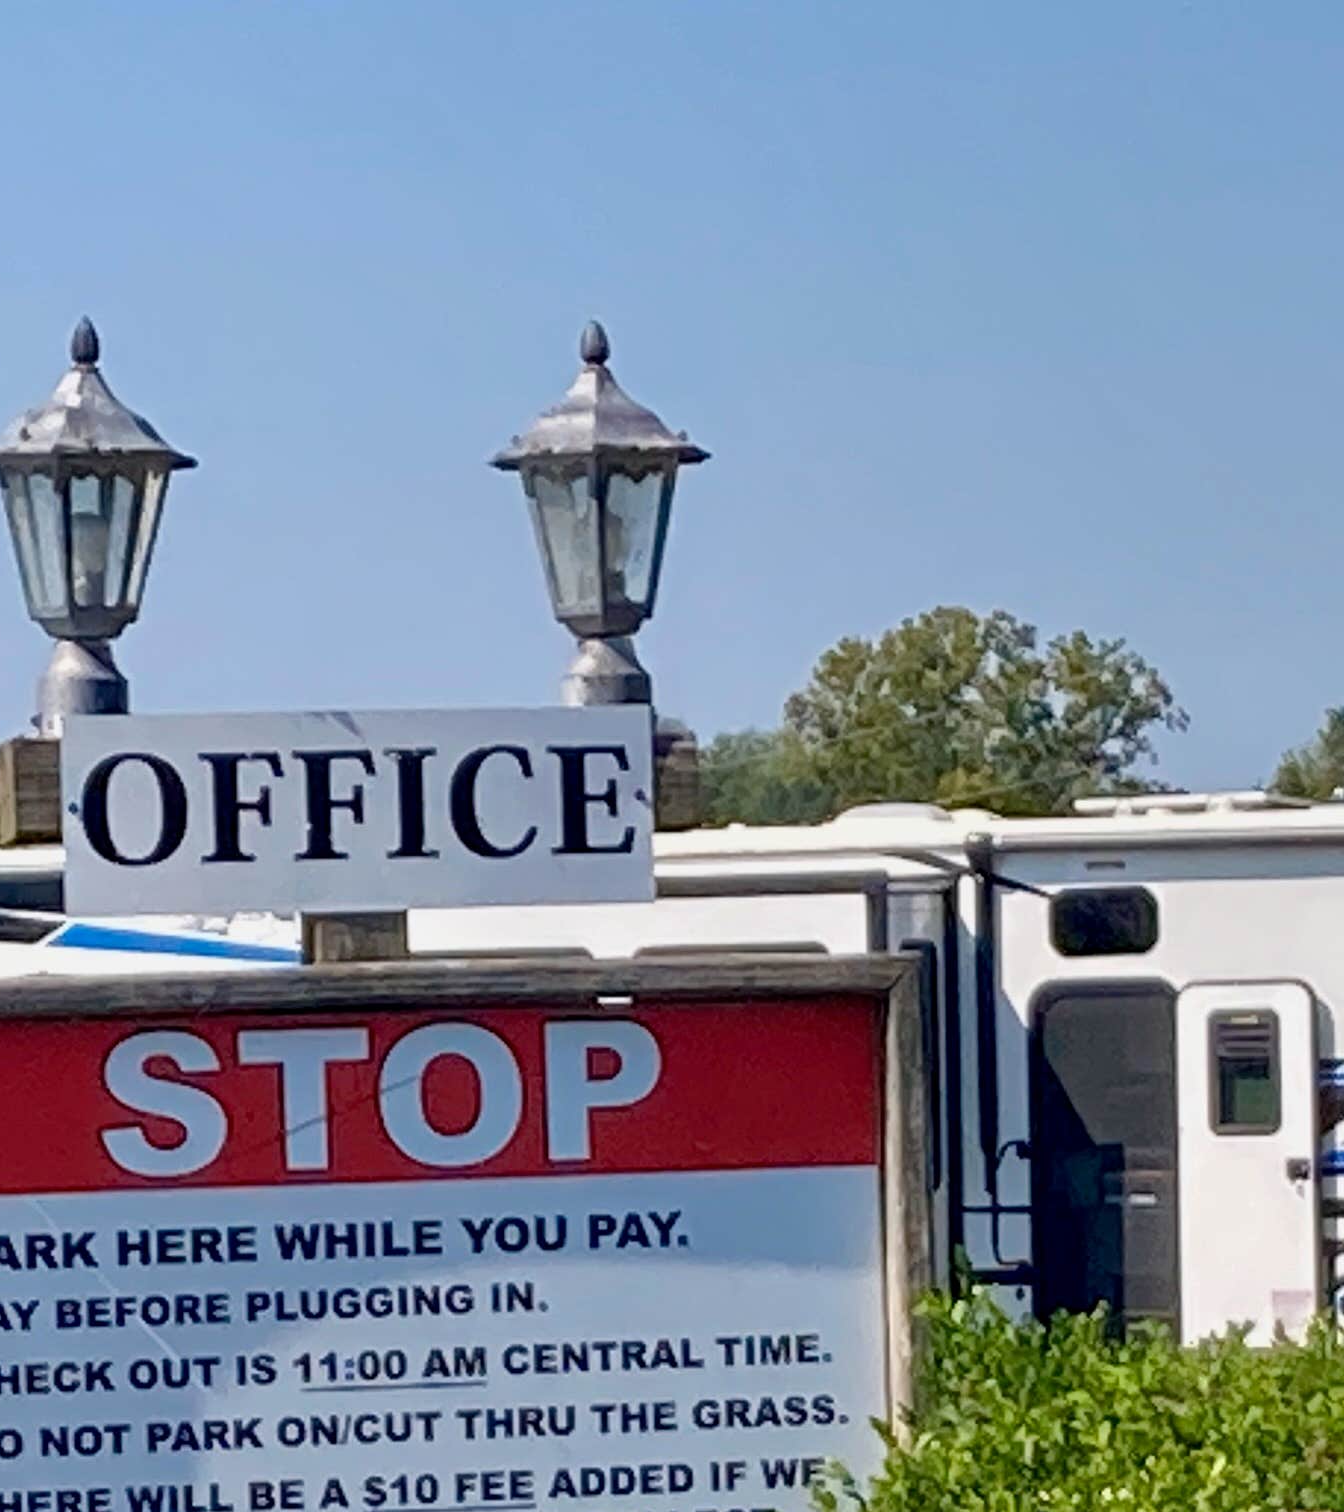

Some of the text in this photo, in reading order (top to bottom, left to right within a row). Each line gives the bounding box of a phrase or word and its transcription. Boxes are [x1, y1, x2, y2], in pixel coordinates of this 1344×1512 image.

[79, 743, 638, 867] OFFICE
[101, 1018, 660, 1178] STOP
[116, 1223, 258, 1267] HERE
[273, 1216, 444, 1262] WHILE
[459, 1212, 568, 1255] YOU
[588, 1209, 689, 1251] PAY.
[55, 1292, 231, 1330] BEFORE
[245, 1283, 475, 1323] PLUGGING
[491, 1281, 549, 1313] IN.
[127, 1355, 222, 1391] OUT
[236, 1354, 278, 1387] IS
[293, 1349, 408, 1384] 11:00
[421, 1346, 488, 1378] AM
[502, 1338, 705, 1376] CENTRAL
[715, 1334, 832, 1367] TIME.
[39, 1423, 132, 1457] NOT
[146, 1416, 264, 1454] PARK
[277, 1410, 443, 1448] ON/CUT
[455, 1404, 576, 1440] THRU
[589, 1400, 678, 1435] THE
[692, 1394, 849, 1430] GRASS.
[248, 1479, 305, 1512] BE
[319, 1478, 350, 1510] A
[455, 1470, 534, 1504] FEE
[548, 1463, 694, 1499] ADDED
[710, 1460, 747, 1492] IF
